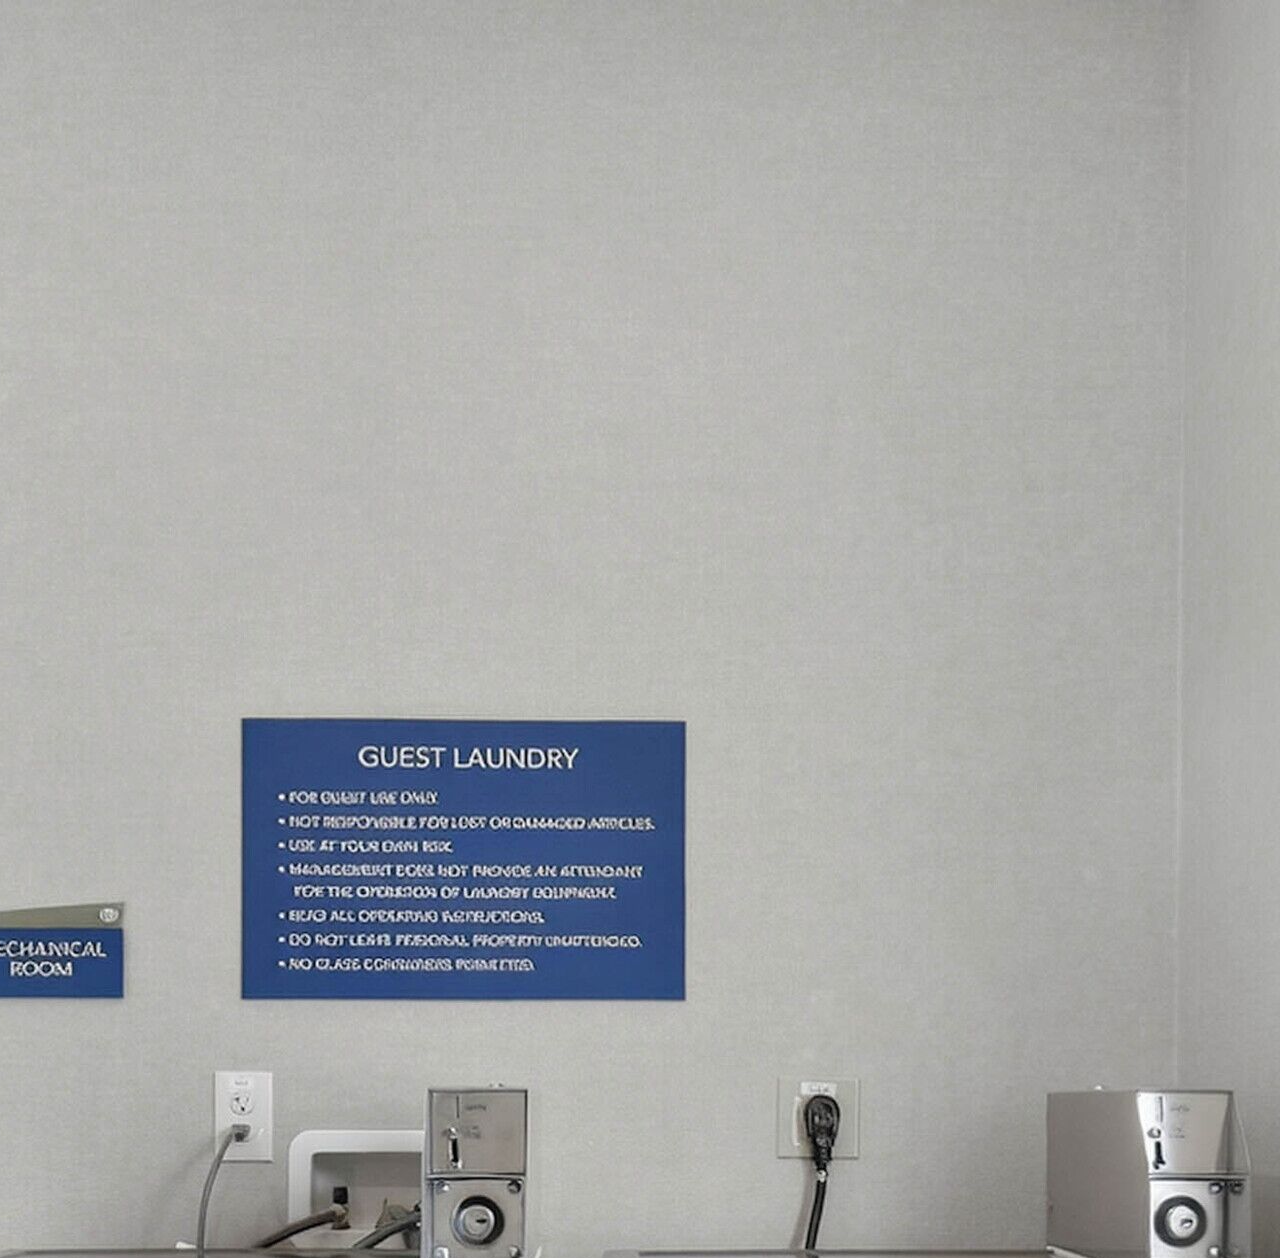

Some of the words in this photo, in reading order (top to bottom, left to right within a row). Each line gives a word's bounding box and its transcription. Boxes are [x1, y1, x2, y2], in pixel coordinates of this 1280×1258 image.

[358, 745, 447, 769] GUEST
[453, 747, 579, 769] LAUNDRY
[288, 790, 318, 805] FOR
[289, 815, 321, 829] NOT
[418, 815, 449, 830] FOR
[489, 816, 512, 830] OR
[288, 933, 312, 947] DO
[10, 960, 73, 977] ROOM
[288, 957, 313, 971] NO
